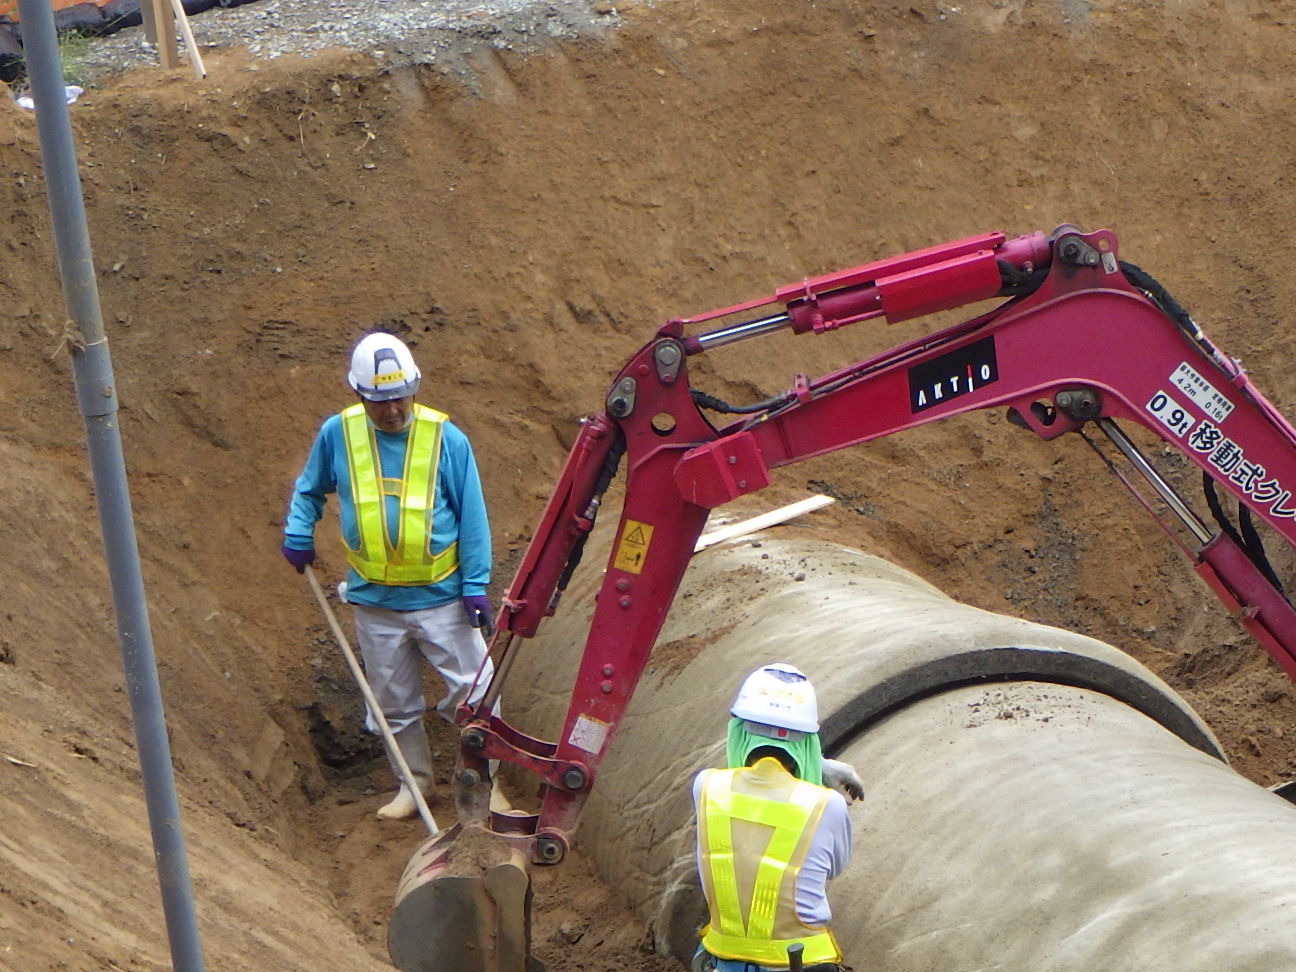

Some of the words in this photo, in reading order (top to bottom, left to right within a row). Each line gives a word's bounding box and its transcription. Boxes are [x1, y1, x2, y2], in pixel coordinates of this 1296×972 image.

[918, 364, 990, 407] AKTIO
[1176, 376, 1198, 398] 4.2m
[1204, 400, 1224, 422] 0.16t
[1149, 393, 1190, 436] 0.9t
